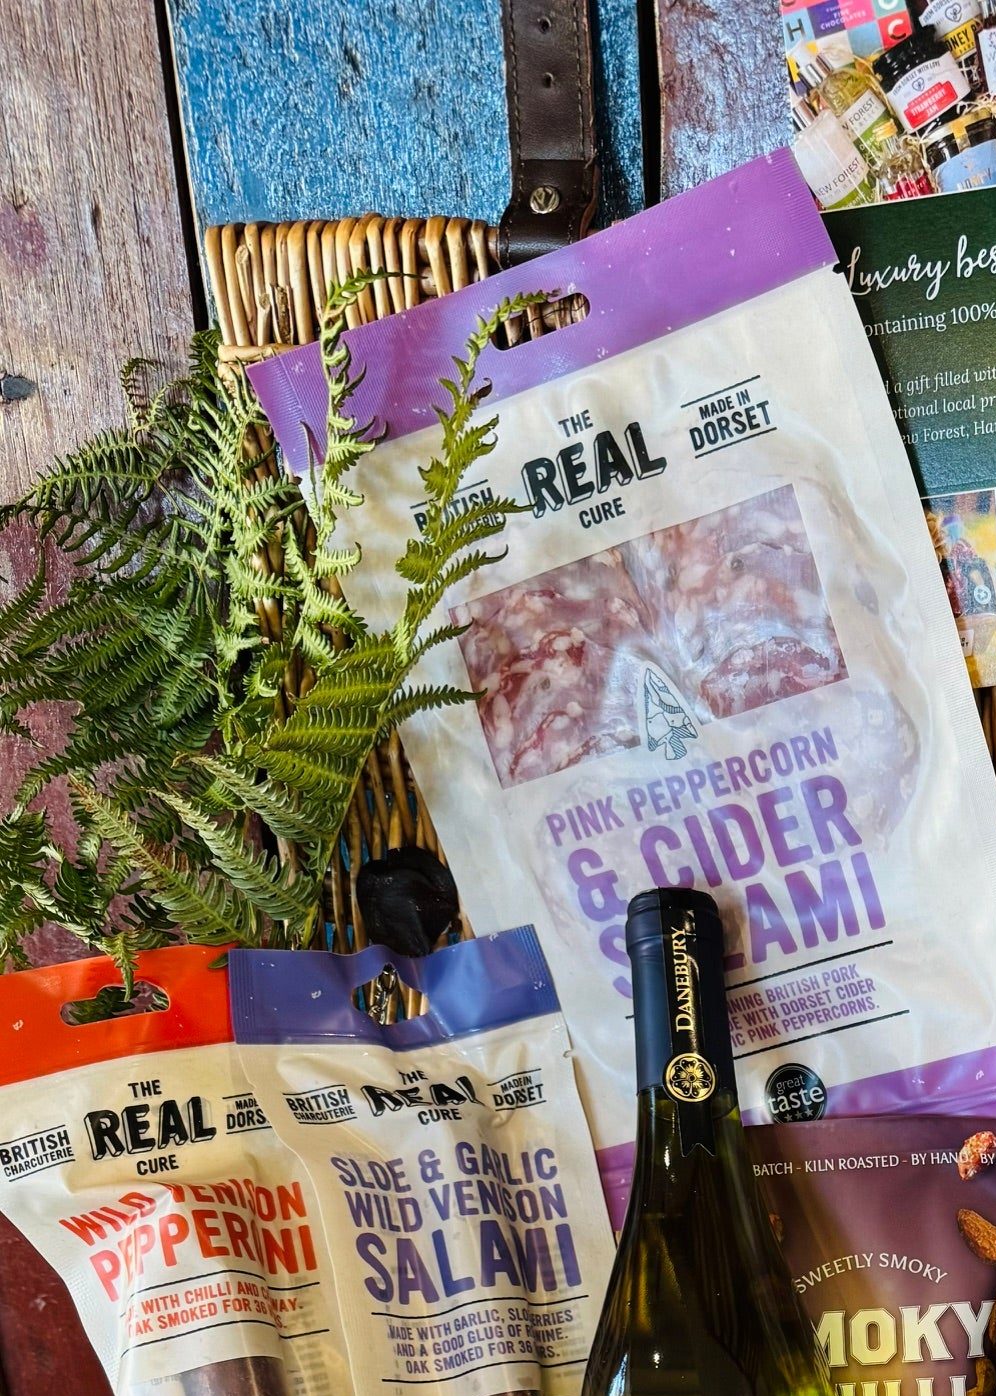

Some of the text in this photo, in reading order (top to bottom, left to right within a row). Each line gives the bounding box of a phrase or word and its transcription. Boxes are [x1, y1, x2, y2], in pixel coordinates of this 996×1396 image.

[848, 247, 950, 300] Luxury
[864, 312, 947, 338] ontaining
[559, 410, 594, 433] THE
[942, 397, 976, 413] local
[690, 401, 771, 451] DORSET
[923, 422, 970, 444] Forest,
[521, 421, 668, 517] REAL
[579, 498, 627, 530] CURE
[546, 727, 839, 844] PINK PEPPERCORN
[567, 775, 863, 922] & CIDER
[671, 926, 694, 1033] DANEBURY
[750, 997, 879, 1043] PINK PEPPERCORNS.
[768, 1086, 825, 1115] taste
[776, 1077, 806, 1095] great
[1, 1130, 71, 1166] BRITISH
[4, 1147, 75, 1177] CHARCUTERIE
[331, 1141, 558, 1192] SLOE & GARLIC
[753, 1155, 899, 1177] BATCH KILN ROASTED
[345, 1183, 568, 1232] WILD VENISON
[89, 1209, 318, 1303] PEPPERONI
[354, 1221, 584, 1306] SALAMI
[795, 1253, 948, 1294] SWEETLY SMOKY
[141, 1282, 259, 1315] WITH CHILLI AND
[406, 1342, 533, 1374] OAK SMOKED FOR 36
